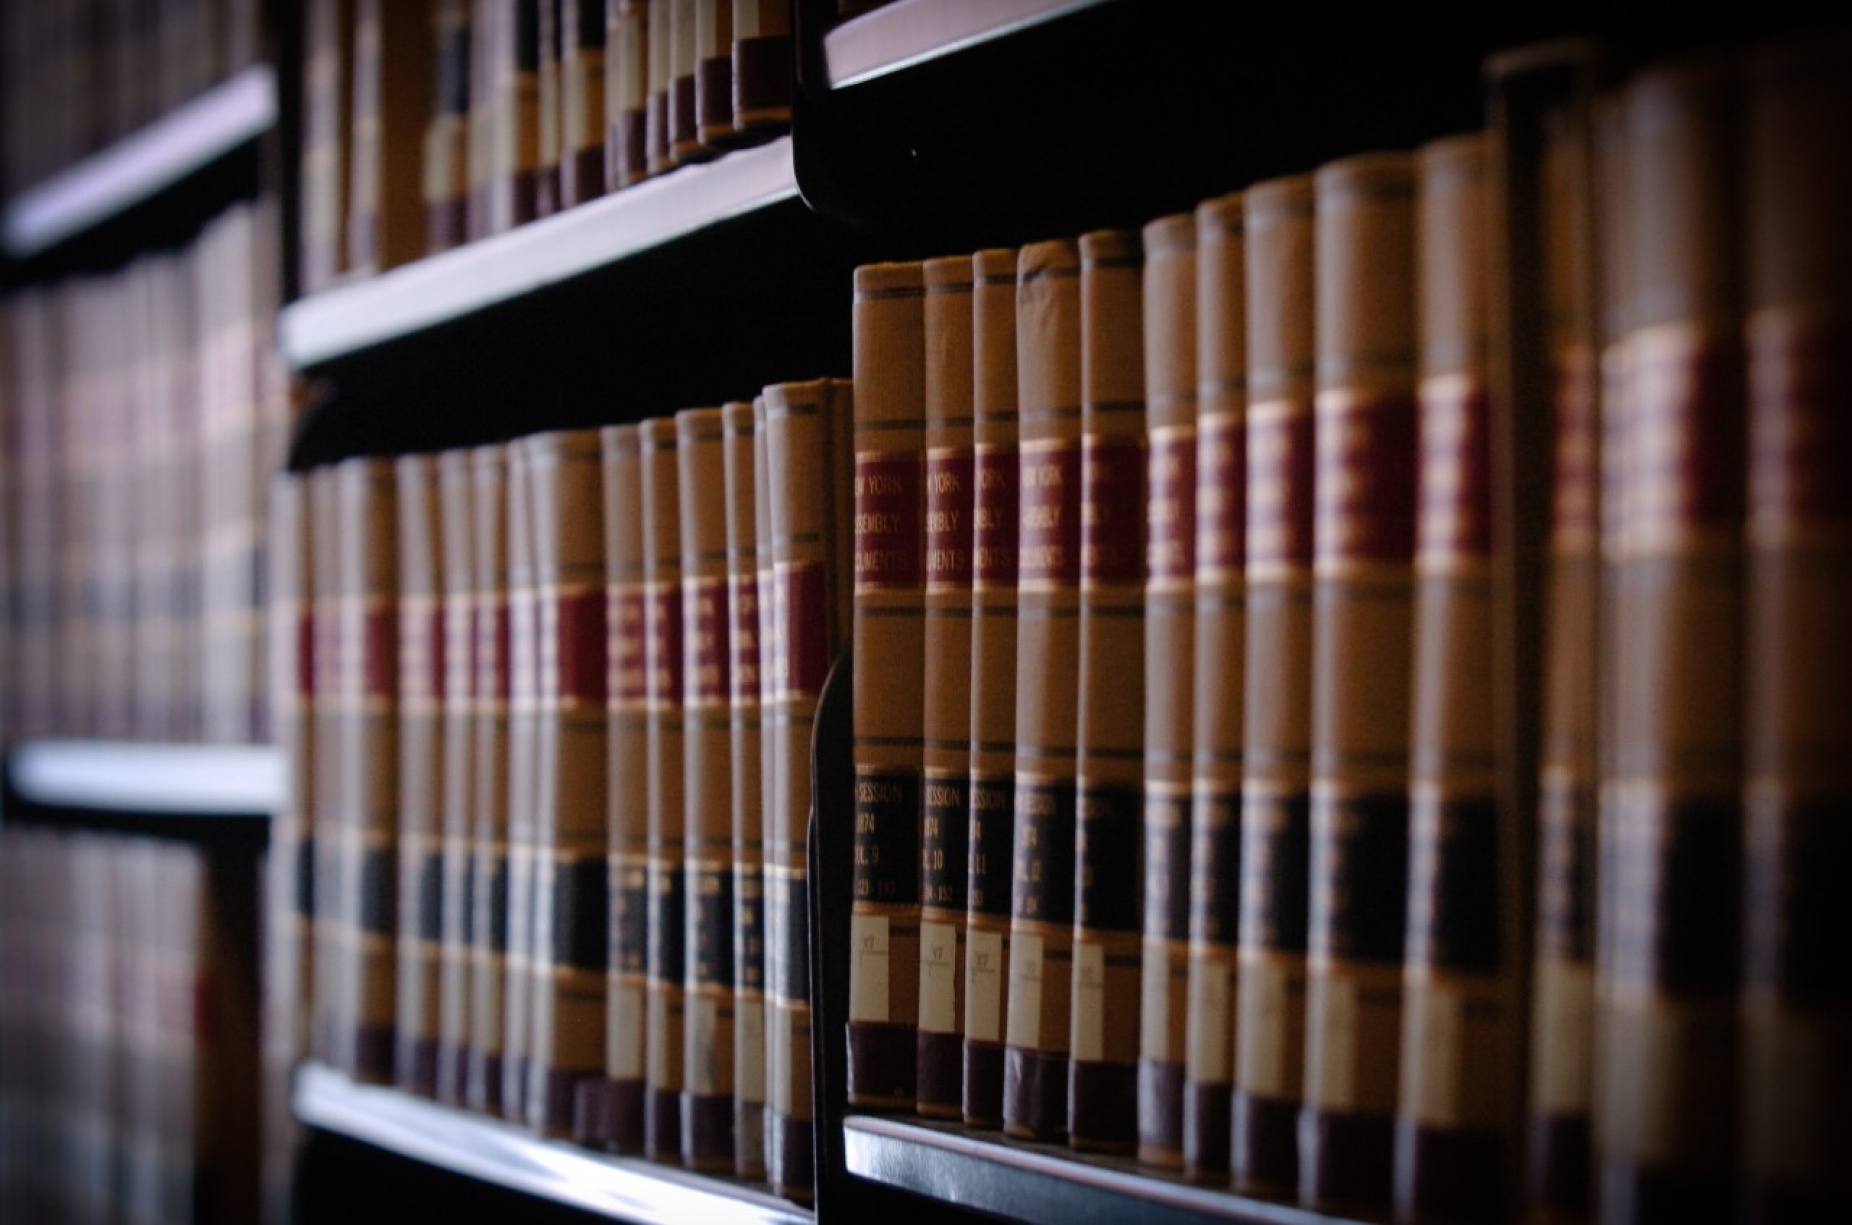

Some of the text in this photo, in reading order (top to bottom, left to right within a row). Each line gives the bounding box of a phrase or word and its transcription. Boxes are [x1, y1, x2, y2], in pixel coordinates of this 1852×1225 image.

[868, 474, 903, 496] YORK
[934, 471, 960, 494] YORK
[870, 842, 880, 866] 9
[932, 848, 945, 870] 10
